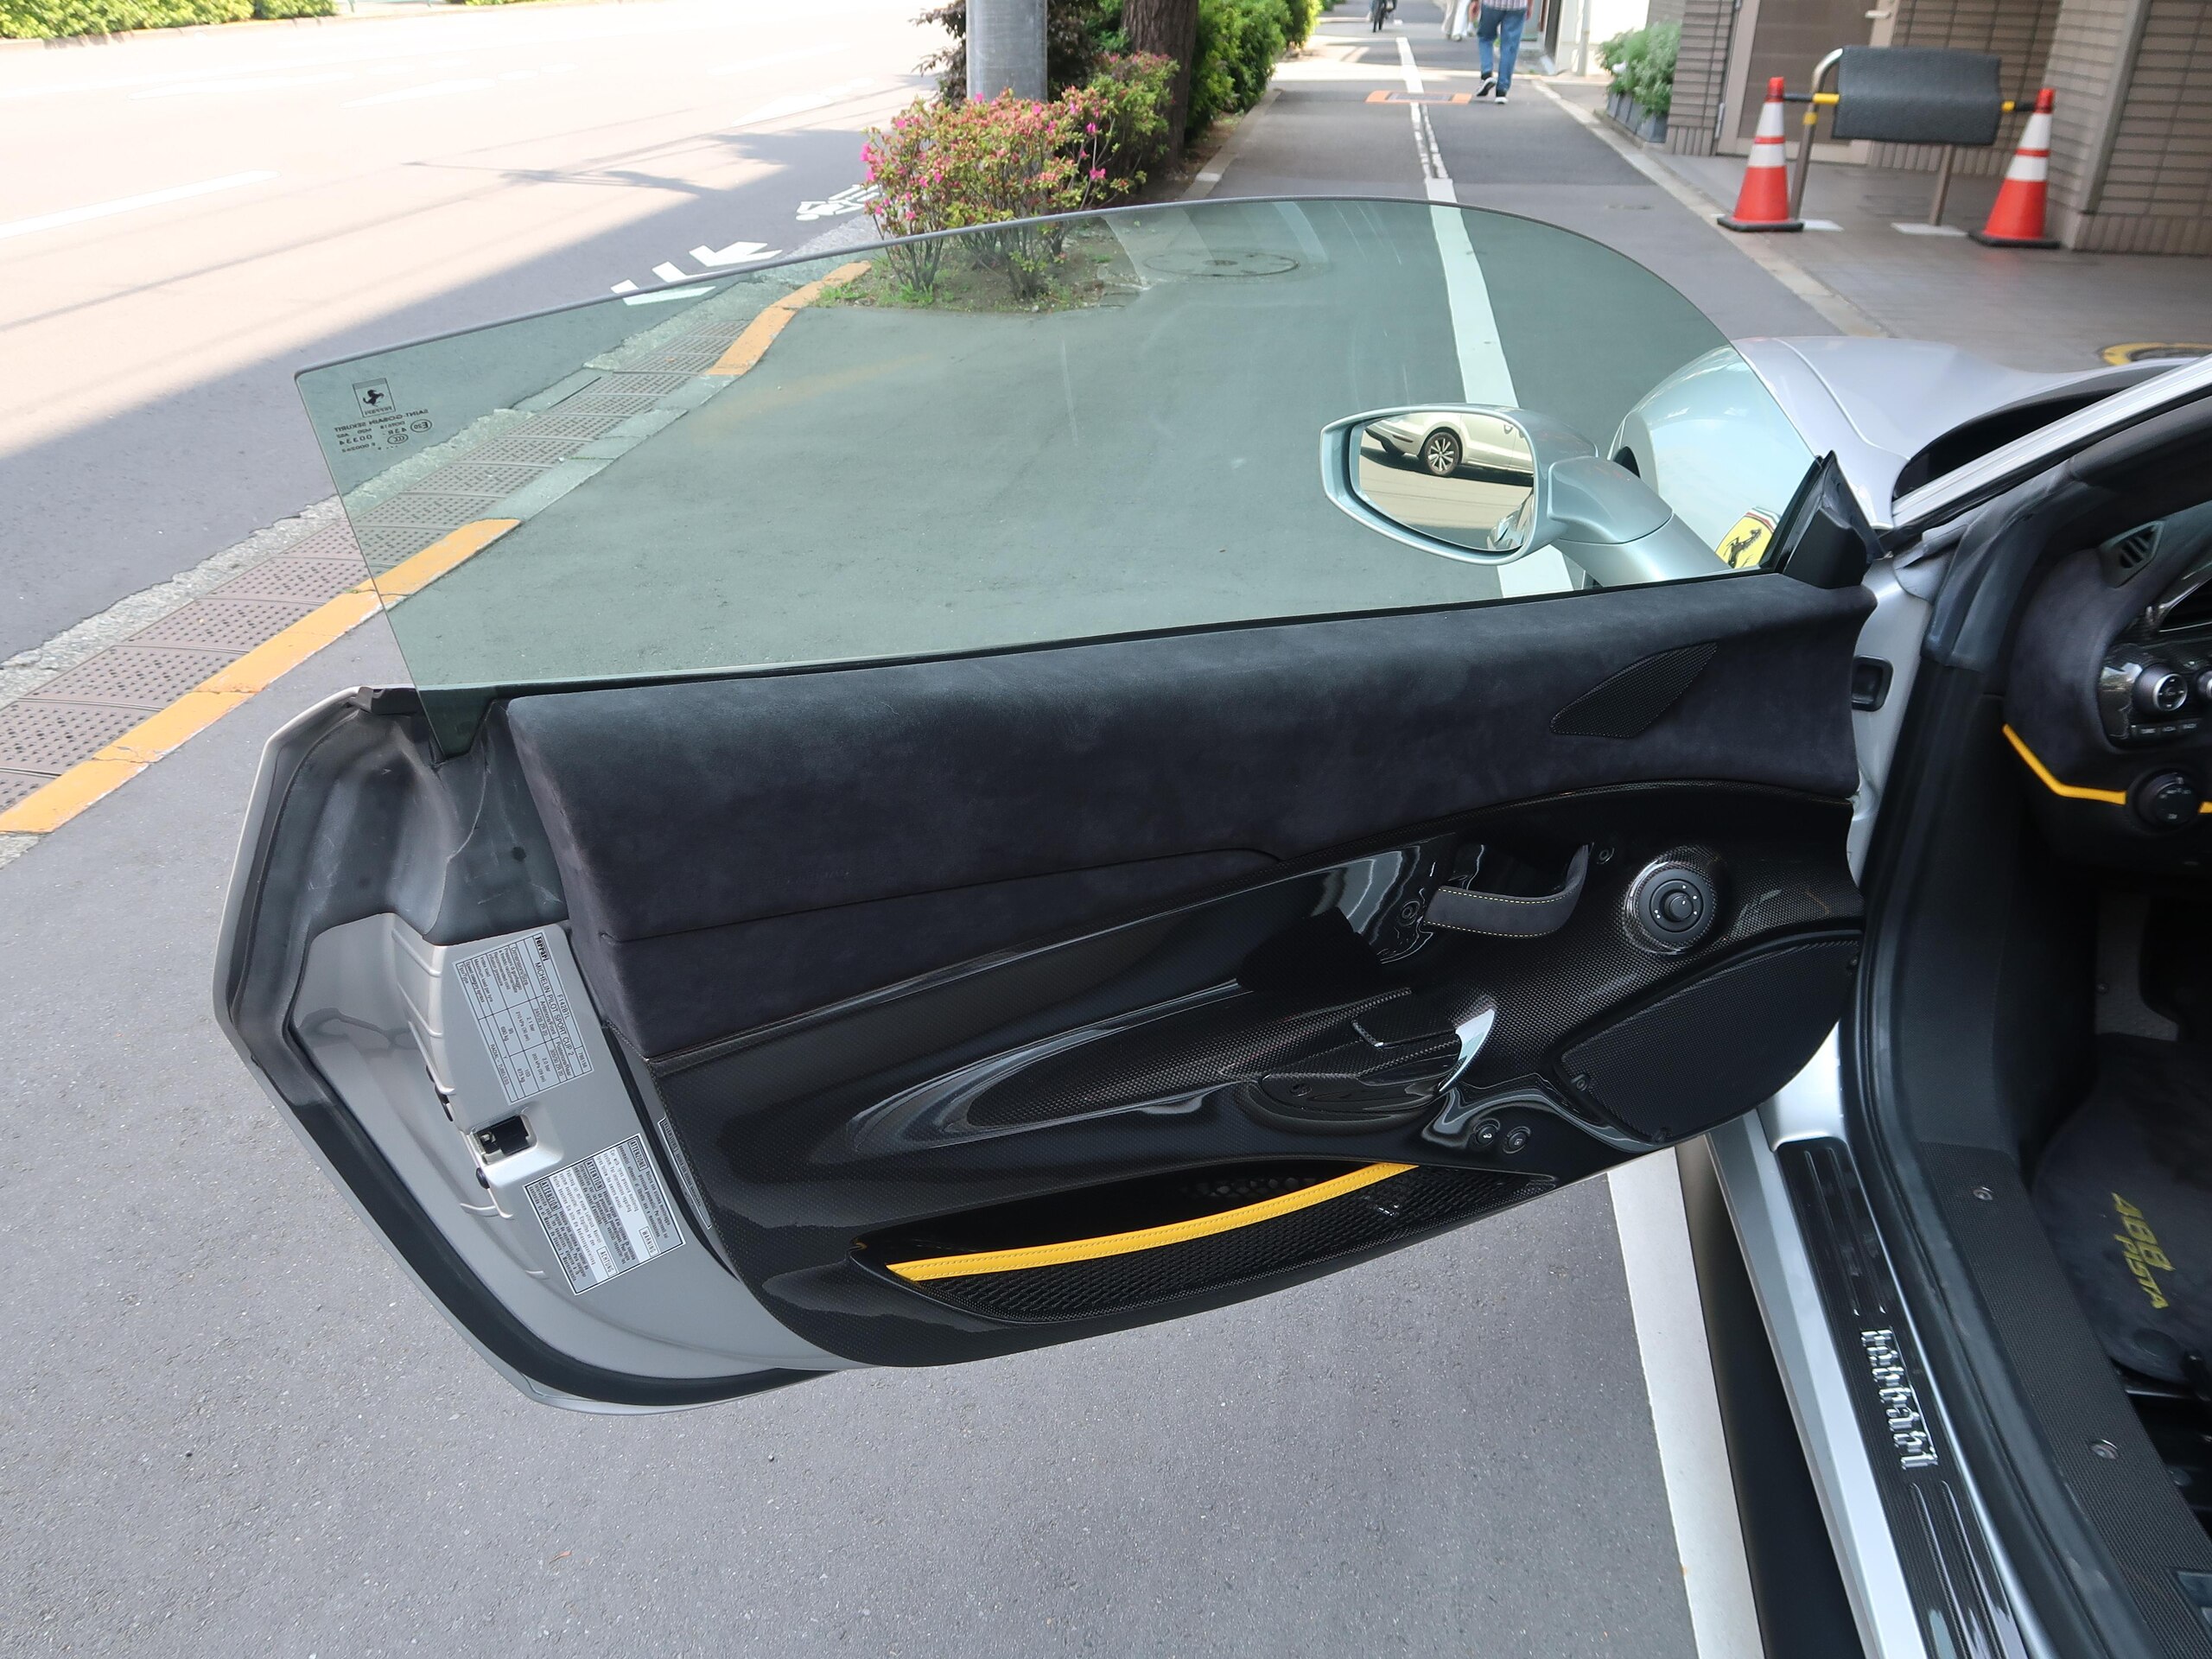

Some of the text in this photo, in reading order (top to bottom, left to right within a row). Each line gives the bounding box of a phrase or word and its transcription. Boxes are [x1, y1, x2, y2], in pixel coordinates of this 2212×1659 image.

[535, 937, 550, 962] Ferrari
[534, 962, 551, 994] MICHELIN
[546, 994, 558, 1013] PILOT
[554, 1014, 567, 1036] SPORT
[563, 1036, 572, 1051] CUP
[629, 1141, 646, 1169] ATTENZIONE
[586, 1160, 603, 1190] ATTENTION
[642, 1230, 656, 1254] WARNING
[600, 1250, 614, 1273] ACHTUNG
[2113, 1233, 2170, 1309] PISTA
